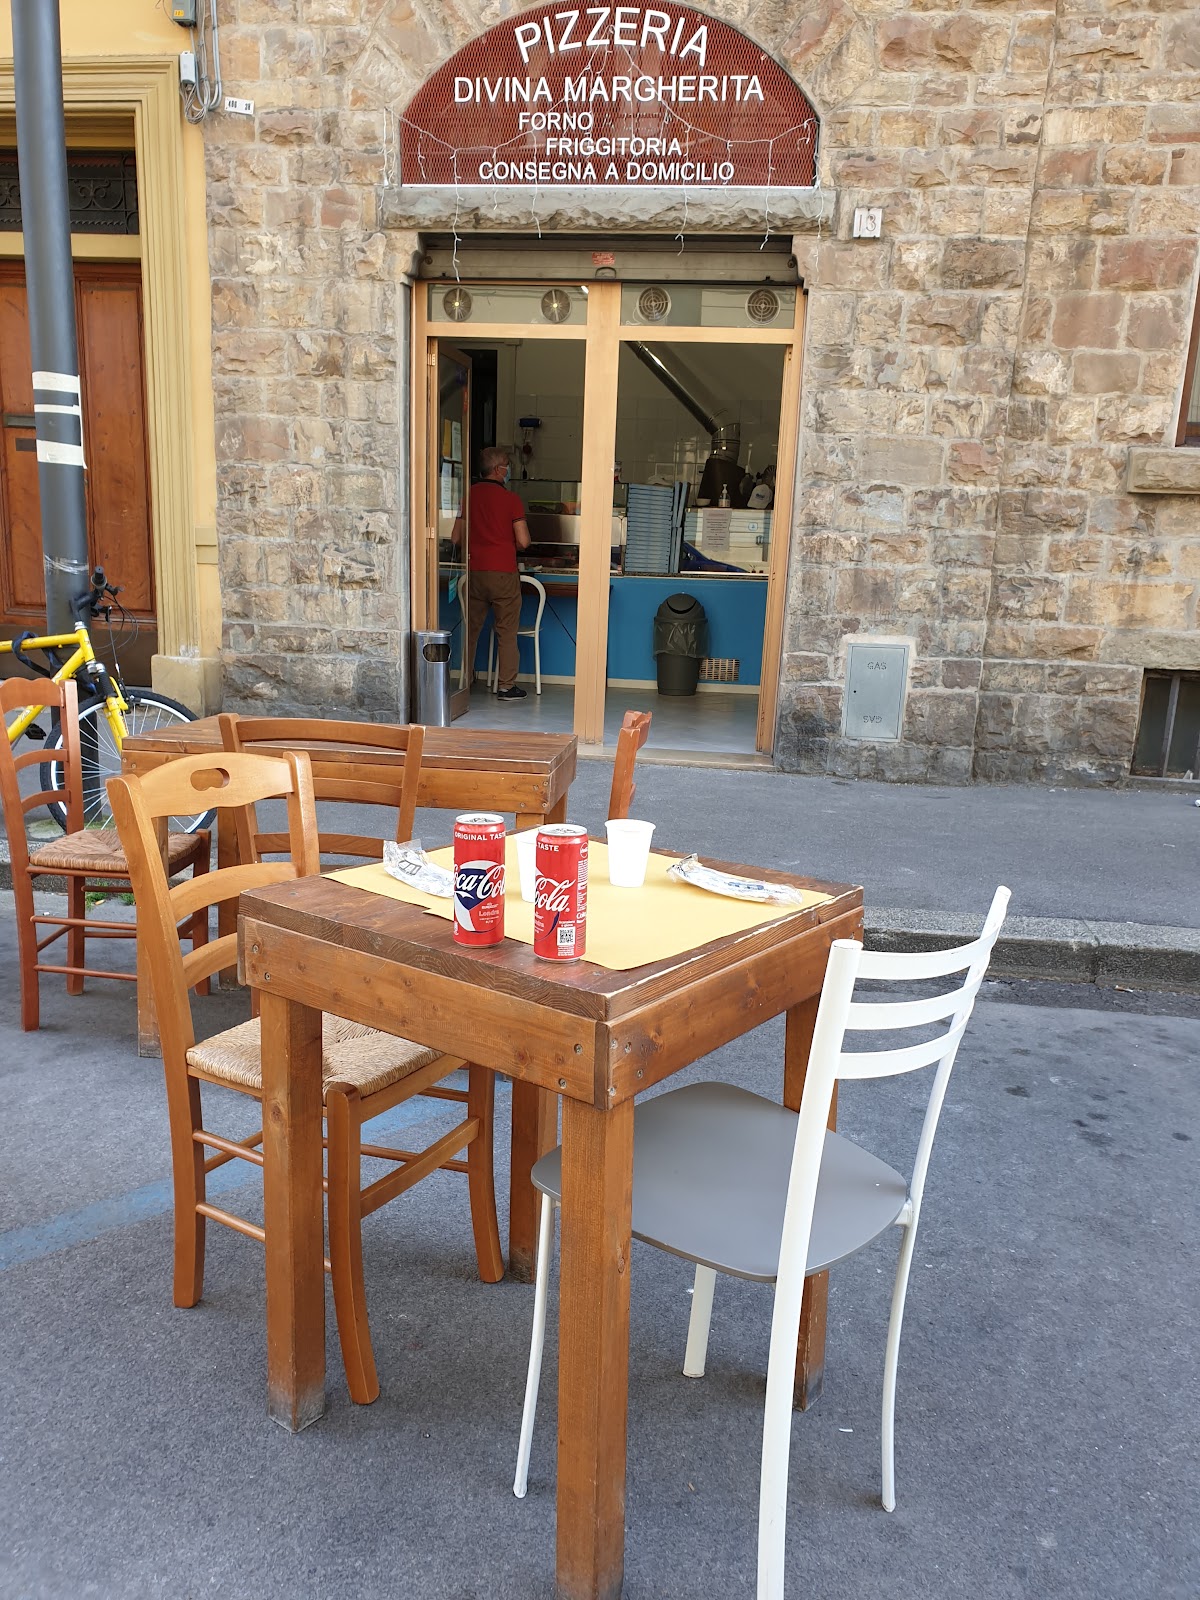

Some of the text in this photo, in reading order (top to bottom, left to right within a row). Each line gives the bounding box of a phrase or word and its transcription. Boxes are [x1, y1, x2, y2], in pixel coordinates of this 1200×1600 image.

[514, 6, 708, 67] PIZZERIA
[454, 74, 765, 103] DIVINA MARGHERITA
[518, 112, 593, 131] FORNO
[546, 137, 682, 156] FRIGGITORIA
[479, 161, 735, 181] CONSEGNA A DOMICILIO
[859, 214, 876, 232] 13
[867, 661, 887, 671] GAS
[454, 831, 488, 841] ORIGINAL
[537, 842, 560, 852] TASTE
